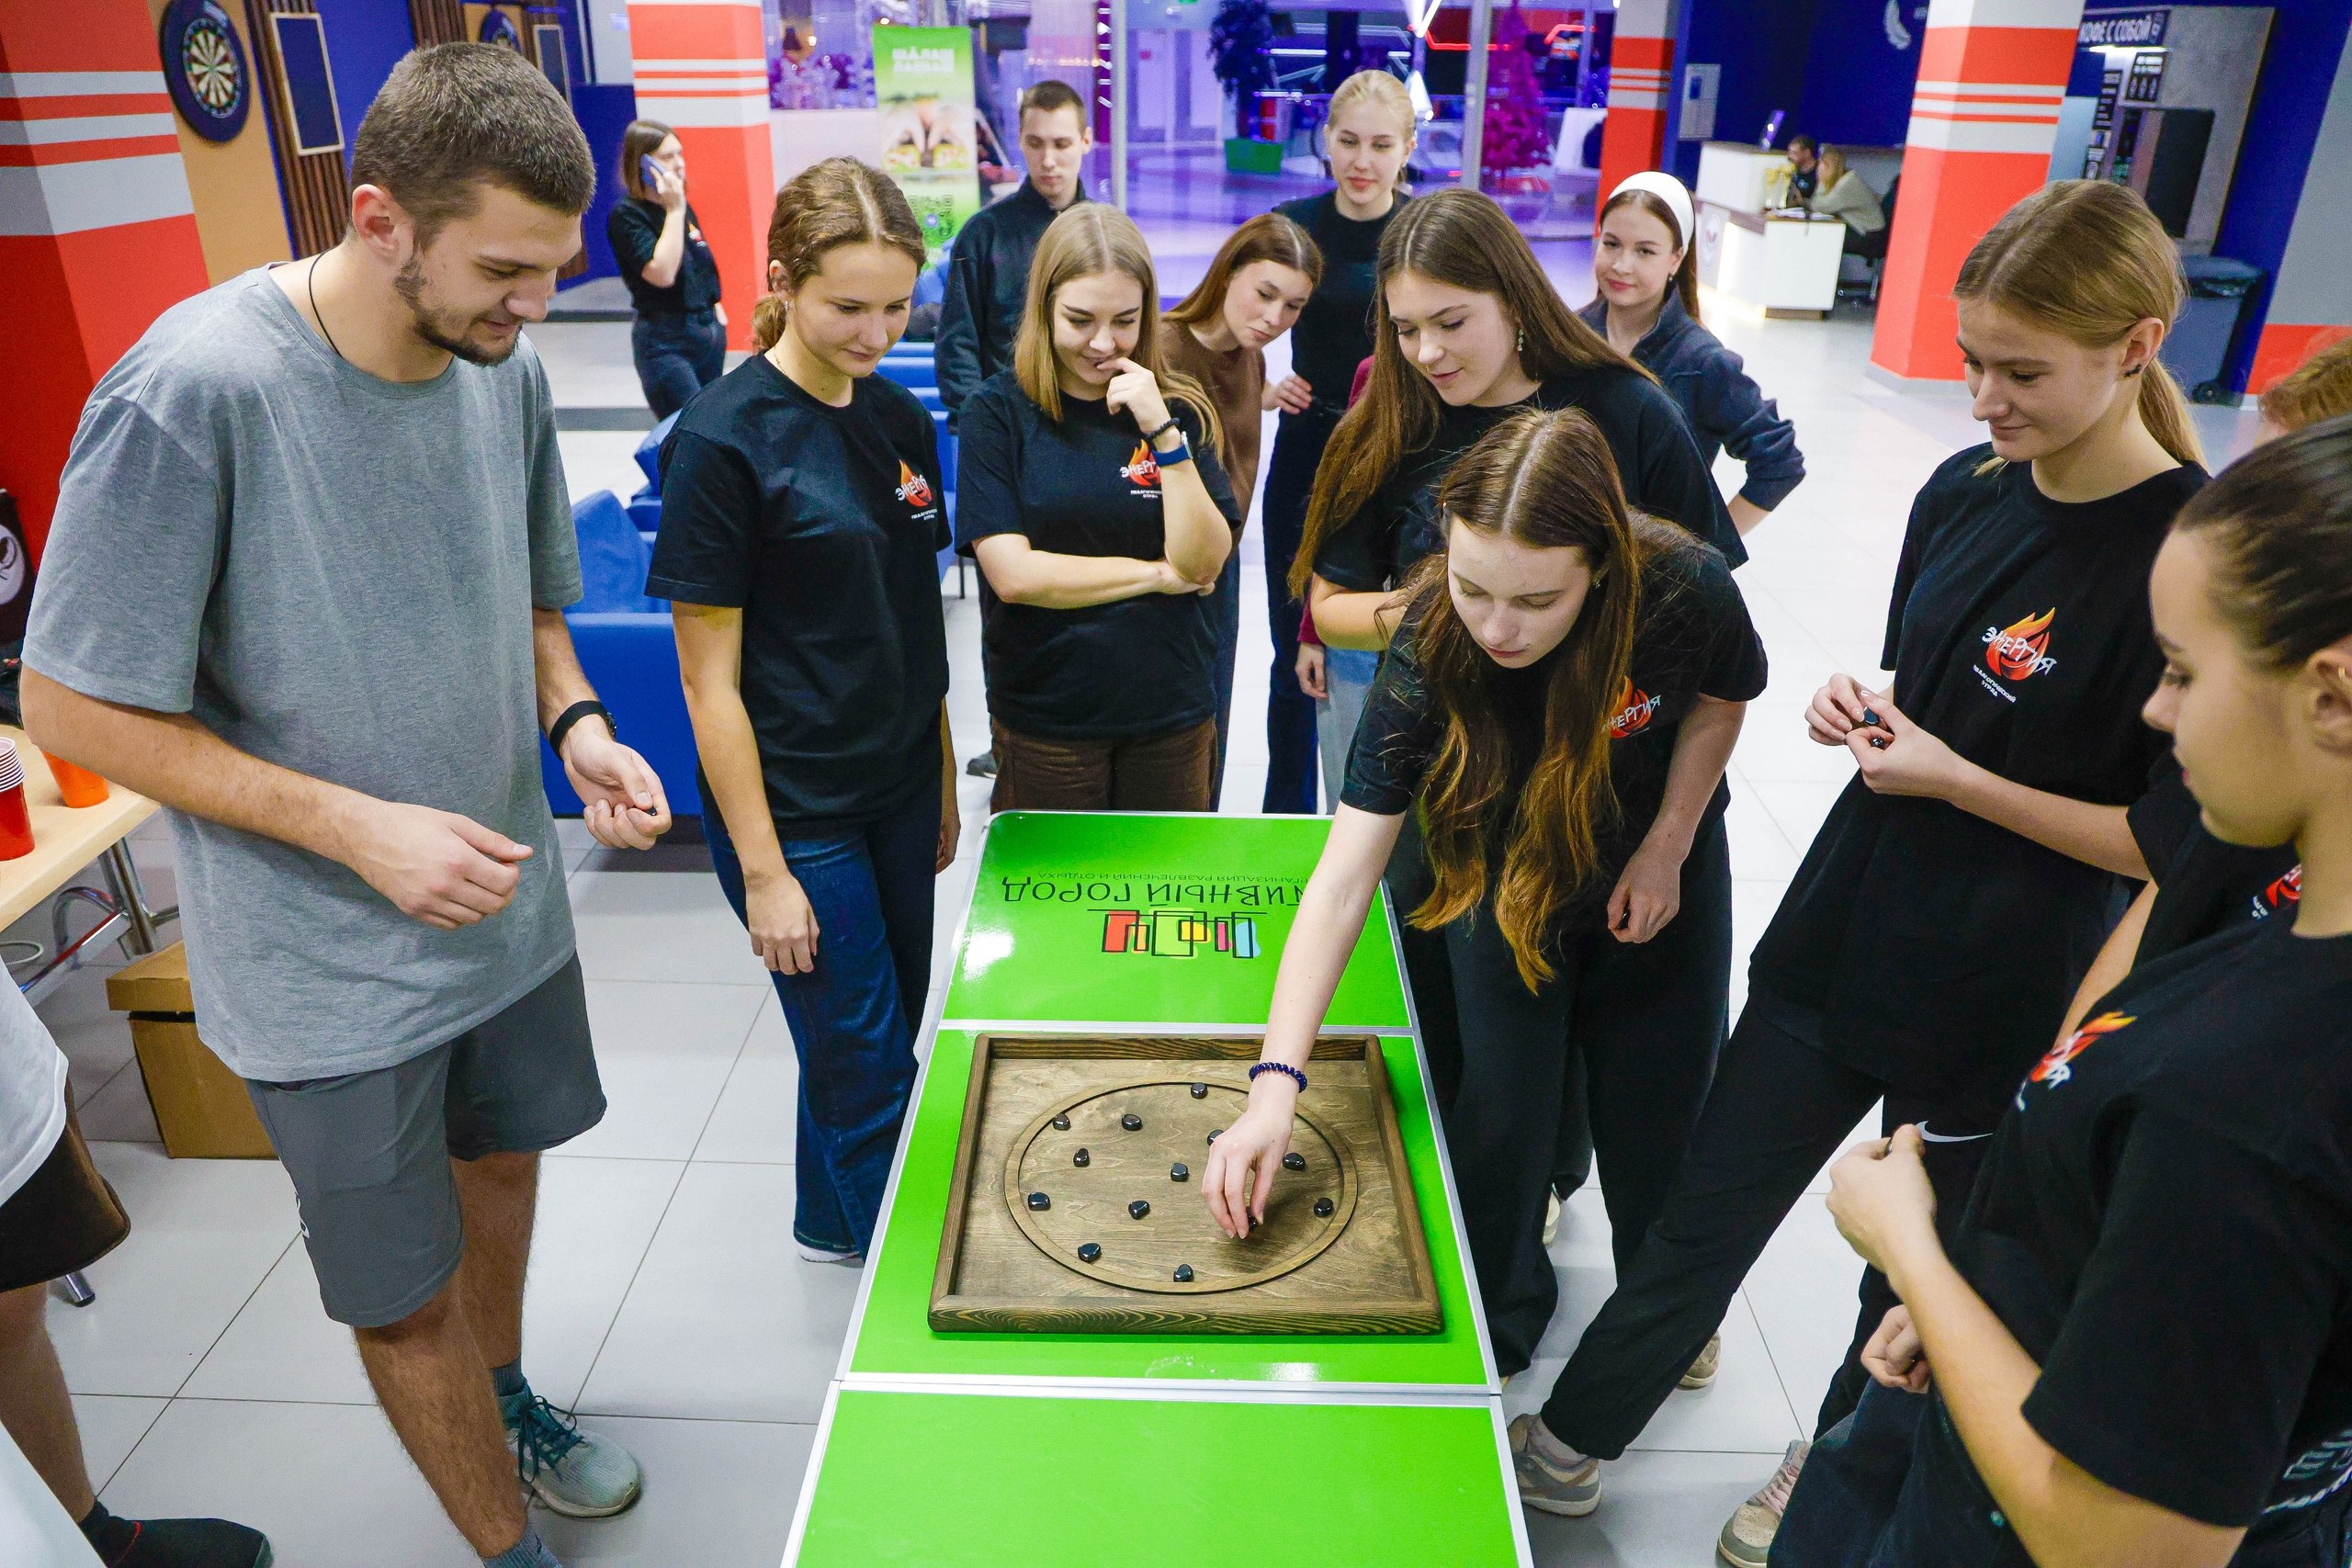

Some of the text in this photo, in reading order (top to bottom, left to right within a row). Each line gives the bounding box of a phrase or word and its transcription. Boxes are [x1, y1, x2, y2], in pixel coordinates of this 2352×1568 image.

[1119, 459, 1157, 478] ЭНЕРГ
[1982, 626, 2057, 676] ЭНЕРГИЯ
[1001, 876, 1303, 906] ТИВНЫЙ ГОРОД
[1216, 875, 1308, 884] РГАНИЗАЦИЯ
